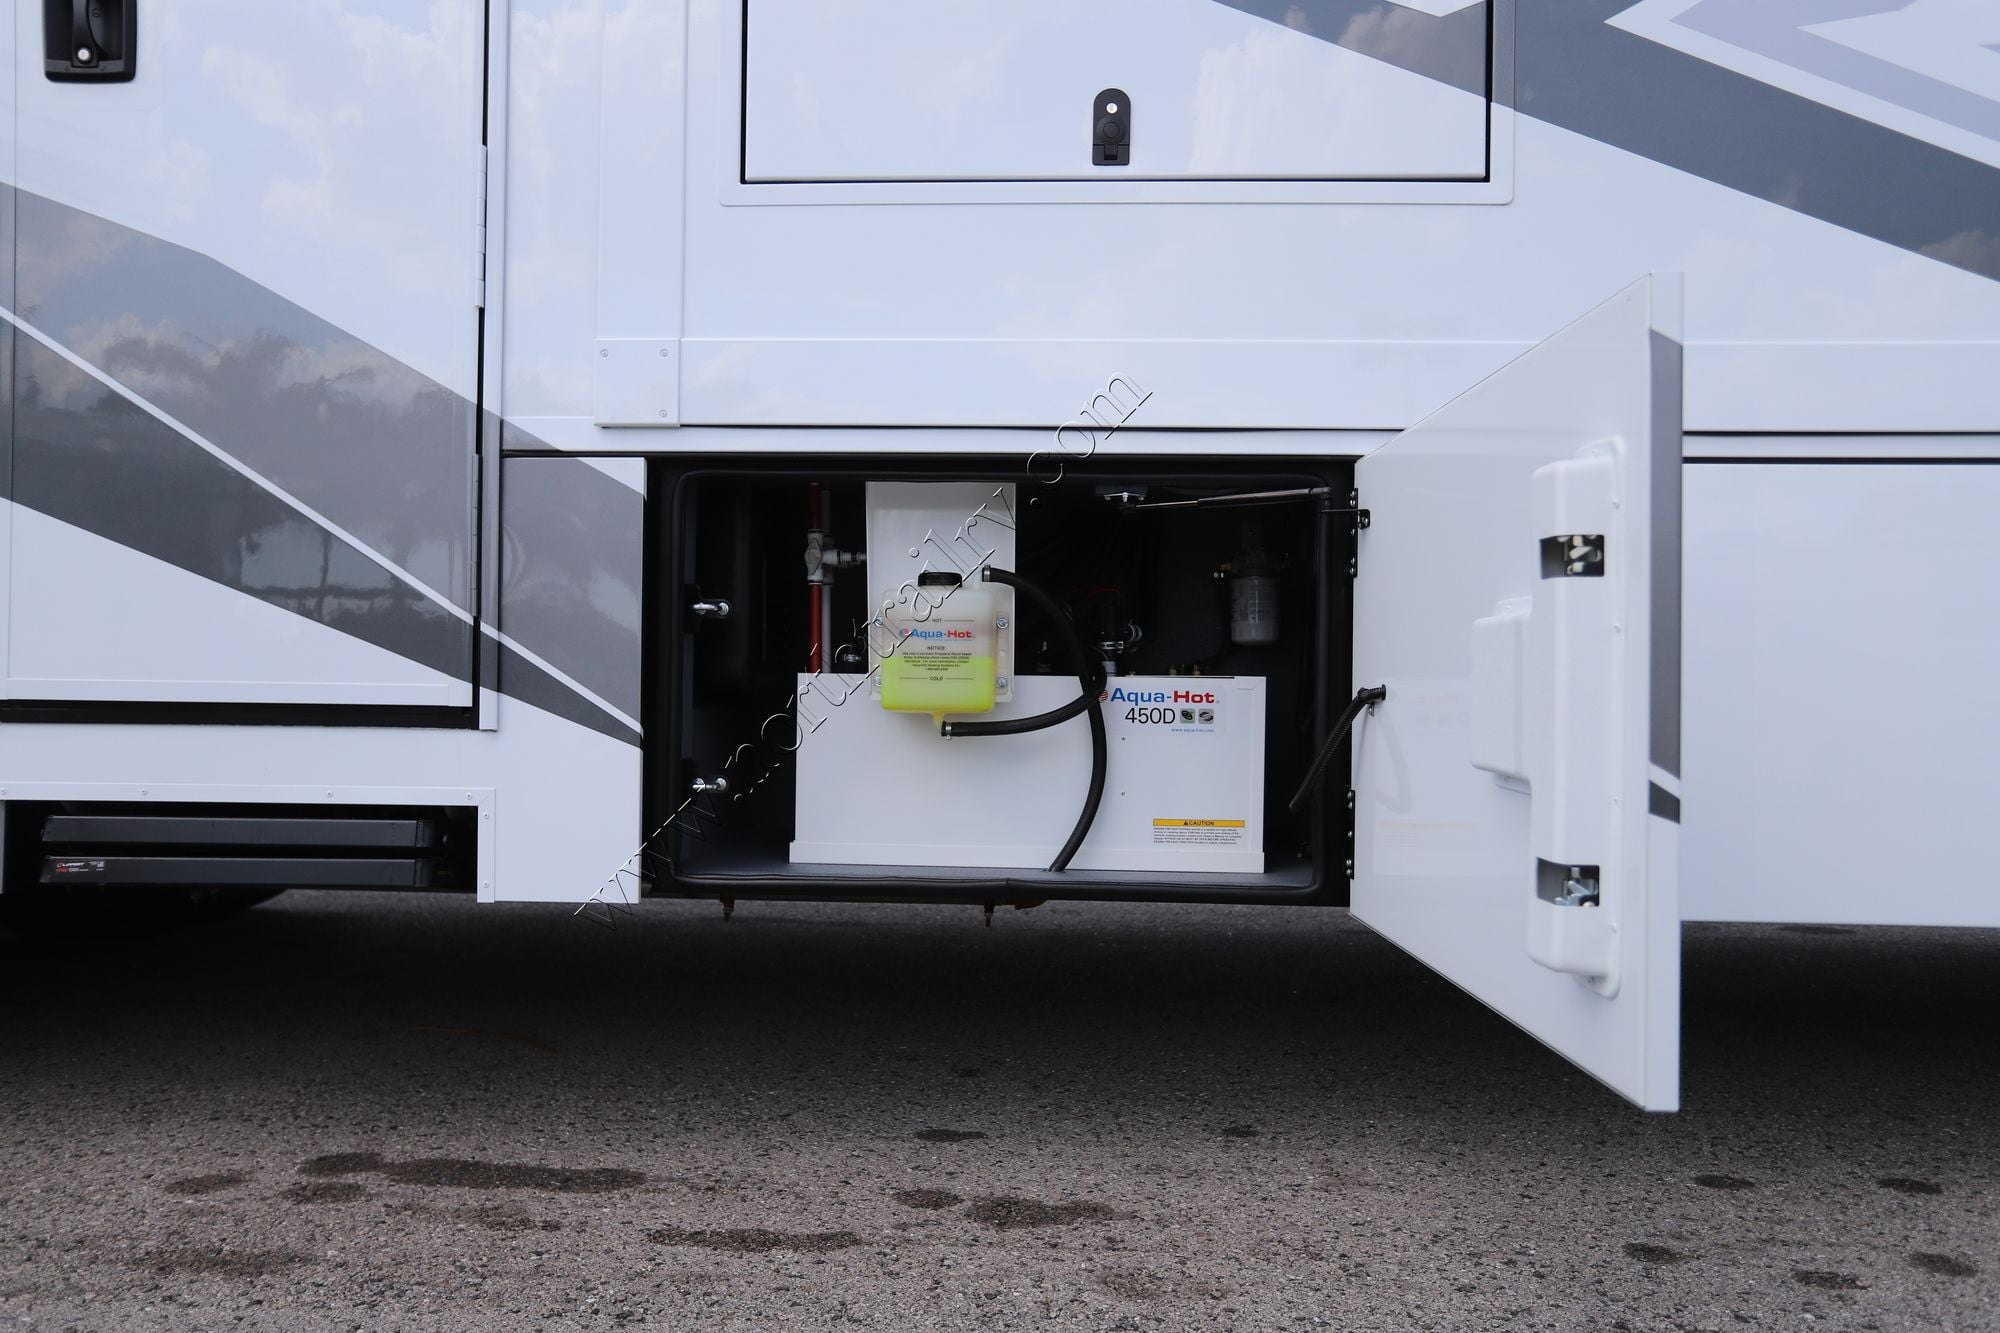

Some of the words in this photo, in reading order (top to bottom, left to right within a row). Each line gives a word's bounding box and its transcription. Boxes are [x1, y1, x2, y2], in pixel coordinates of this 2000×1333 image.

[911, 628, 973, 640] Aqua-Hot
[1110, 687, 1215, 706] Aqua-Hot
[1125, 707, 1176, 724] 450D
